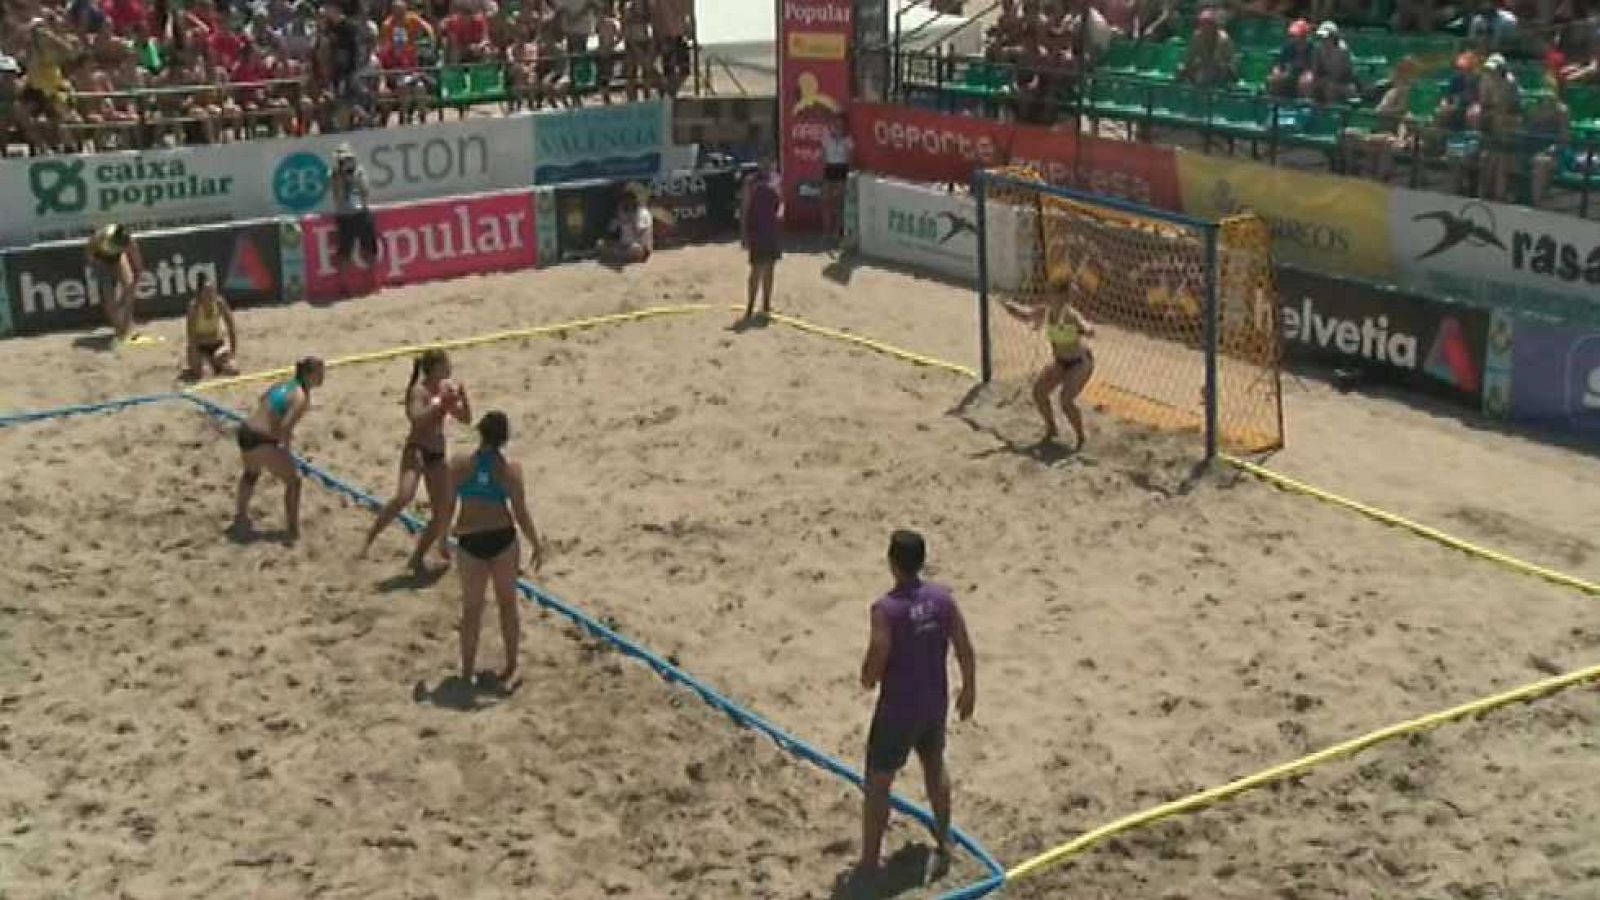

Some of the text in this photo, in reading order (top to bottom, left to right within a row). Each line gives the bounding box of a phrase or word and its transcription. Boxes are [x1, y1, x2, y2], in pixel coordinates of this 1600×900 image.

[783, 0, 850, 25] Popular
[95, 156, 185, 182] caixa
[97, 174, 233, 211] popular
[20, 252, 217, 314] heletia
